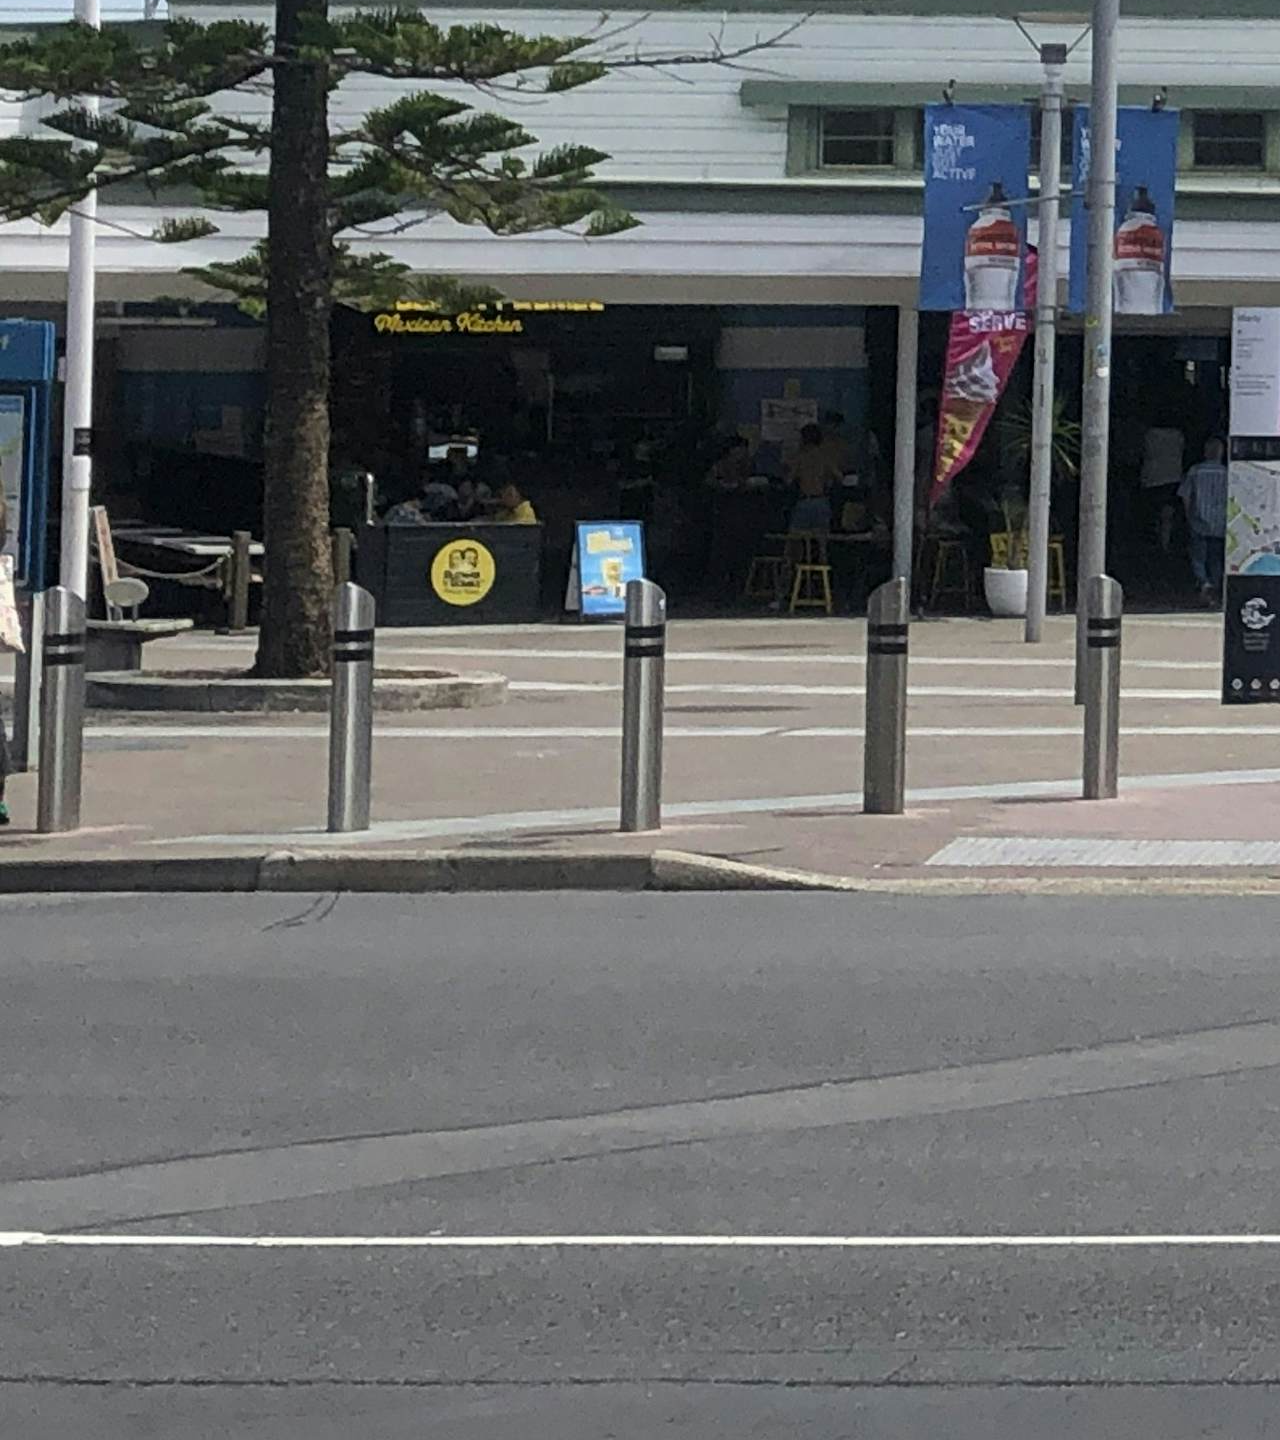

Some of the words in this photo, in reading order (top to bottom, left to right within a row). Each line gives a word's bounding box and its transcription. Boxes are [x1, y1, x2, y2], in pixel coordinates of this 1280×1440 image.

[374, 311, 453, 334] Mexican
[455, 311, 524, 333] Kitchen
[968, 313, 1027, 333] SERVE
